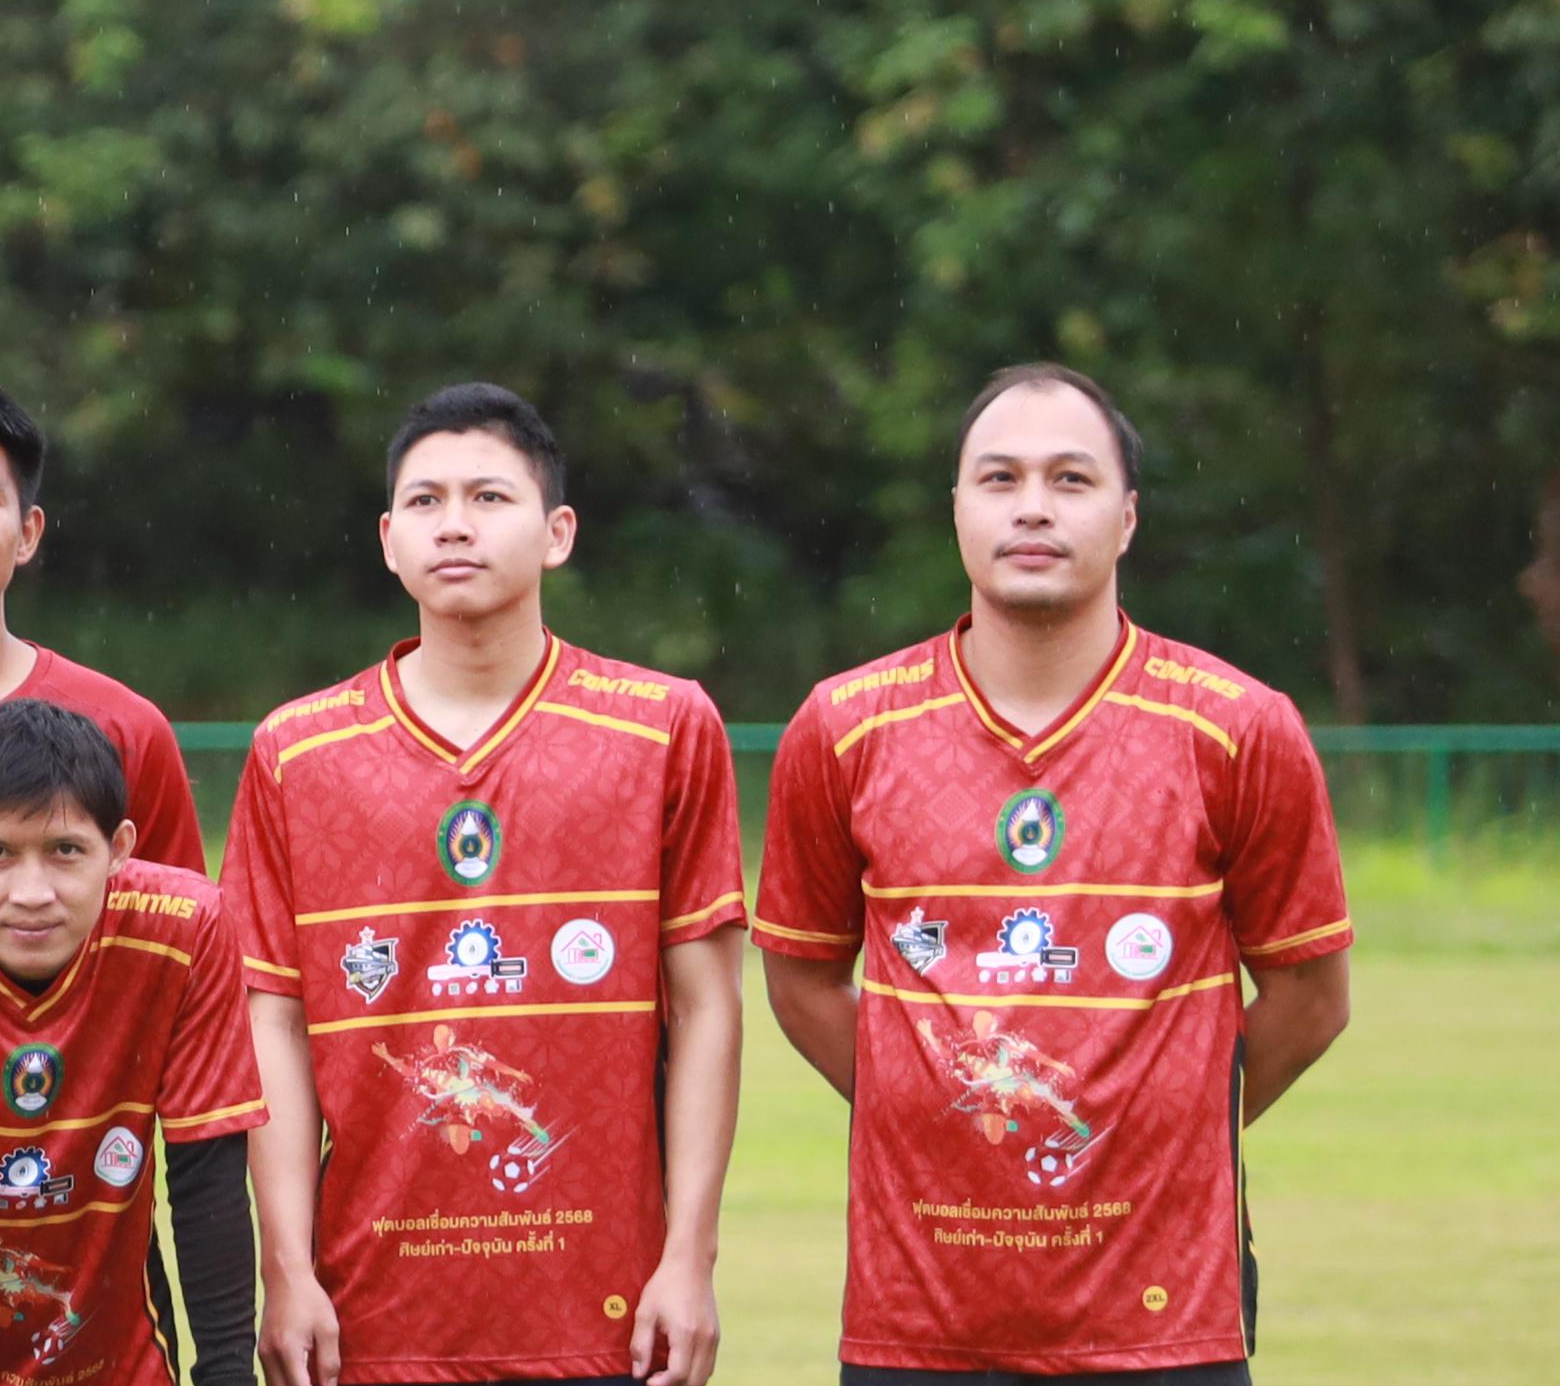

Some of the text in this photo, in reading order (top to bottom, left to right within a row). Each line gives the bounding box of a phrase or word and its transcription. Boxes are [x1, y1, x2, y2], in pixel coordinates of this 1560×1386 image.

[372, 1208, 593, 1238] ฟุตบอลเชื่อมความสัมพันธ์ 2568
[1093, 1201, 1132, 1217] 2568
[399, 1230, 565, 1259] ศิษย์เก่า-ปัจจุบัน ครั้งที่ 1
